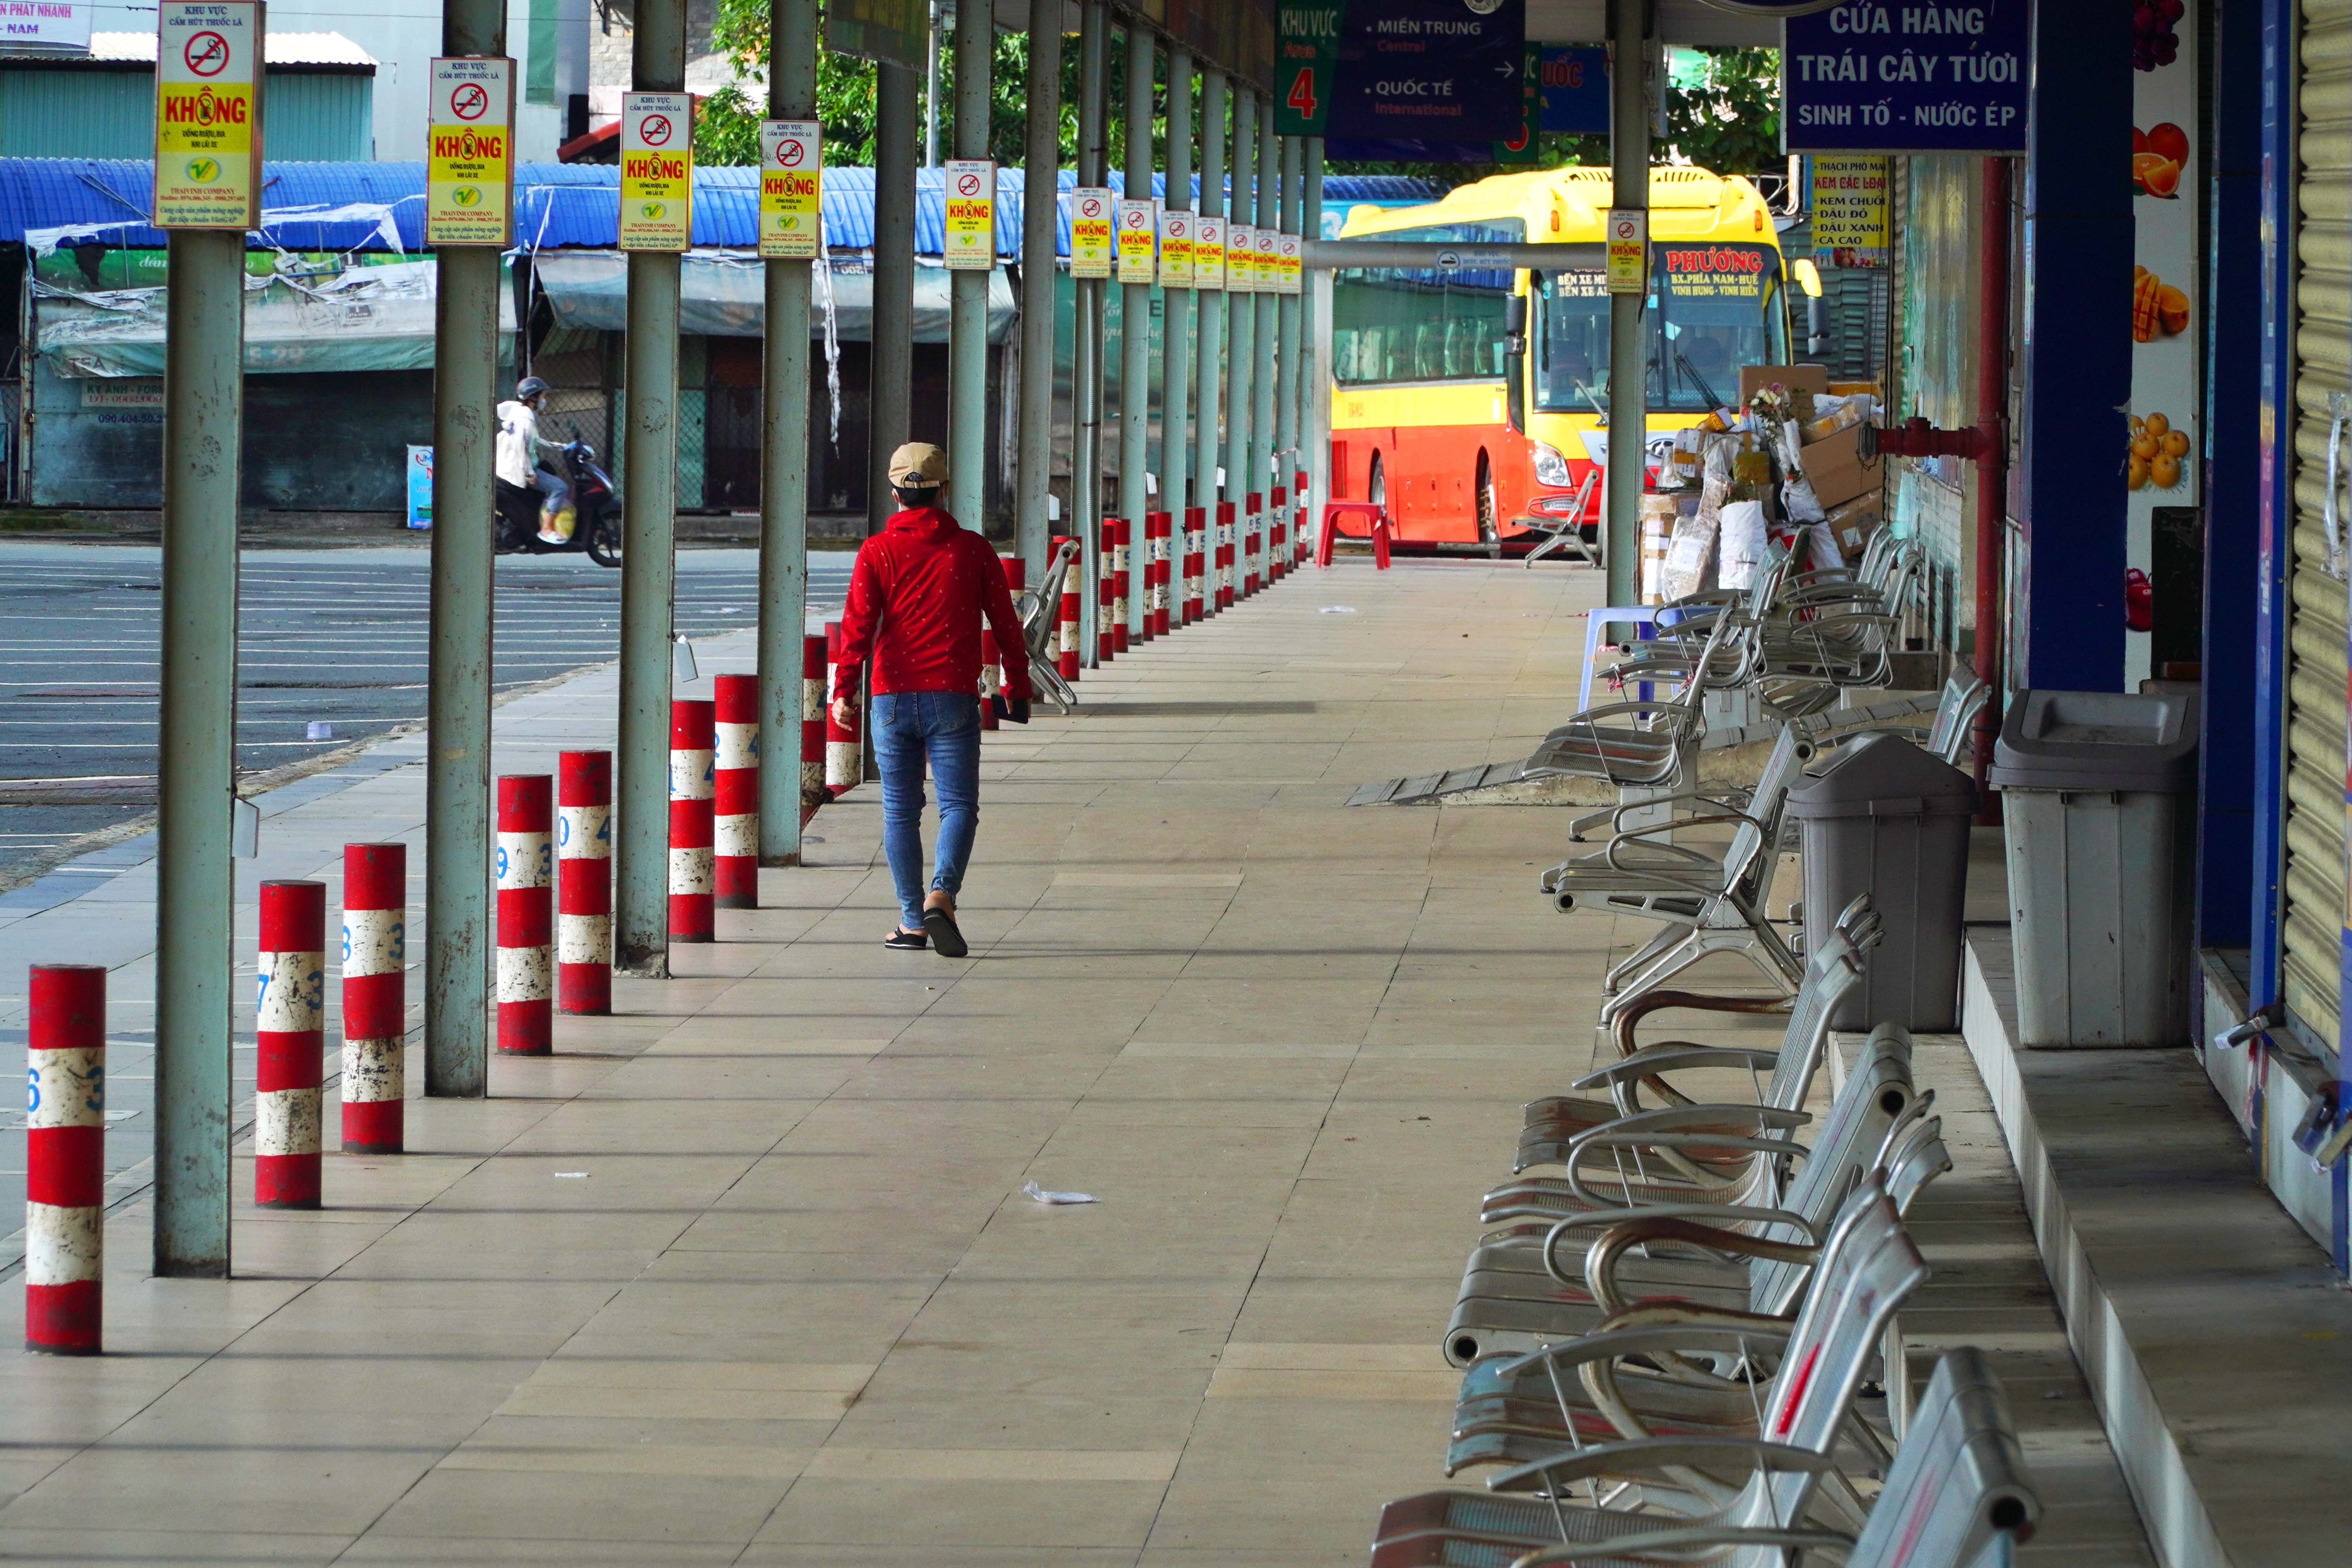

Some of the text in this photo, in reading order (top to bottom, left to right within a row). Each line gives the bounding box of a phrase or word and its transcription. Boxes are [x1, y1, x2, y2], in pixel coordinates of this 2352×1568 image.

[38, 4, 72, 19] NHANH
[1829, 0, 1985, 35] CỬA HÀNG
[7, 24, 39, 33] NAM
[1281, 7, 1337, 45] KHU VỰC
[1424, 20, 1482, 35] TRUNG
[1284, 41, 1316, 59] Area
[1377, 39, 1425, 52] Central
[470, 62, 487, 71] VỰC
[1796, 48, 2018, 83] TRÁI CÂY TƯƠI
[1287, 67, 1317, 119] 4
[1376, 78, 1453, 96] QUỐC TẾ
[166, 85, 246, 126] KHÔNG
[1375, 102, 1462, 116] International
[1798, 97, 2016, 127] SINH TỐ NƯỚC ÉP
[436, 127, 502, 160] KHÔNG
[627, 151, 684, 181] KHÔNG
[1820, 163, 1847, 173] THẠCH
[765, 172, 814, 196] KHÔNG
[1815, 175, 1886, 192] KEM CÁC LOẠI
[1849, 194, 1885, 205] CHUỐI
[950, 200, 989, 219] KHÔNG
[1850, 208, 1868, 218] ĐỎ
[1075, 221, 1108, 236] KHÔNG
[1820, 222, 1845, 234] ĐẬU
[1121, 231, 1151, 246] KHÔNG
[1838, 236, 1862, 244] CAO
[1611, 242, 1641, 257] KHÔNG
[1666, 247, 1764, 273] PHƯƠNG
[1557, 273, 1577, 285] BẾN
[1579, 275, 1592, 285] XE
[1671, 272, 1711, 284] BX.PHÍA
[1559, 285, 1595, 297] BẾN XE
[596, 816, 611, 846] 4
[389, 922, 405, 960] 3
[306, 970, 324, 1010] 3
[85, 1066, 104, 1111] 3
